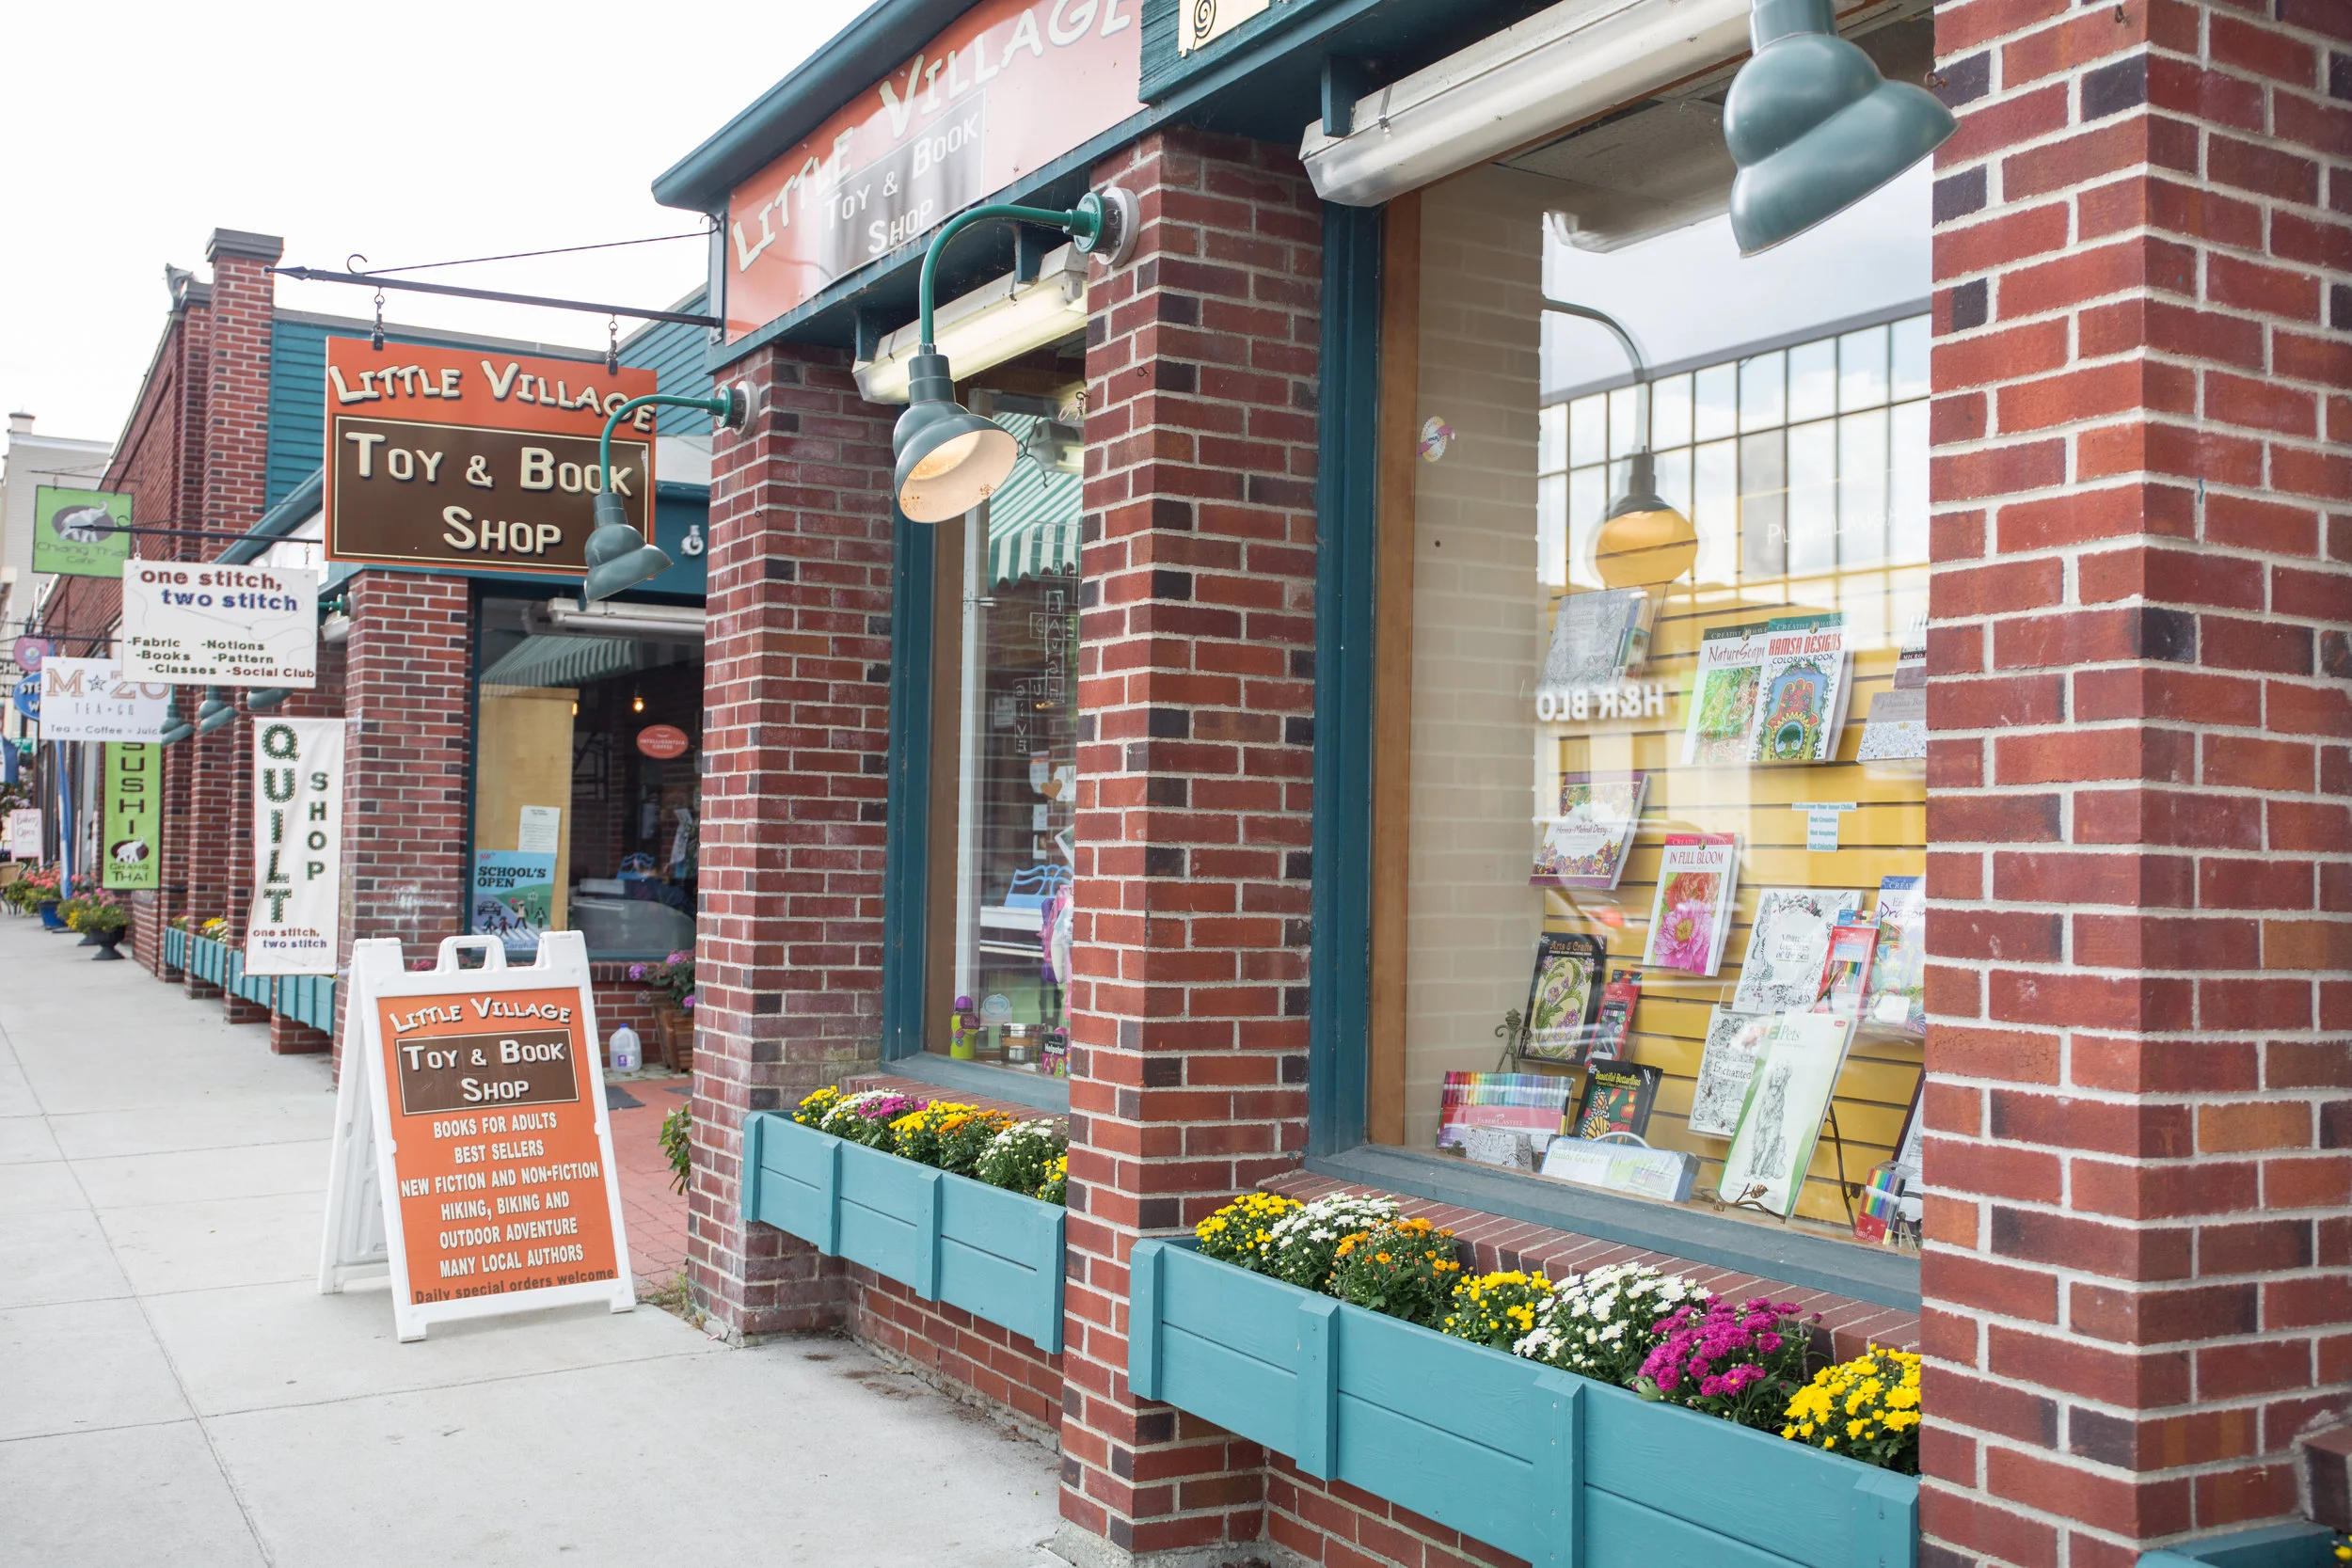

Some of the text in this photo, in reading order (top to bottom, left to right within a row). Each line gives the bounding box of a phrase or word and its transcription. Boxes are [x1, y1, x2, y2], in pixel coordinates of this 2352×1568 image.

[733, 0, 1131, 272] LITTLE VILLAGE
[824, 112, 979, 230] TOY & BOOK
[867, 198, 933, 254] SHOP
[328, 358, 657, 433] LITTLE VILLAGE
[345, 431, 633, 498] TOY & BOOK
[442, 504, 563, 555] SHOP
[140, 570, 282, 592] one stitch,
[162, 589, 298, 611] two stitch
[1776, 622, 1810, 631] CREATIVE
[1769, 633, 1842, 656] HAMSA DESIGNS
[1772, 653, 1835, 665] COLORING BOOK
[283, 668, 314, 678] Club
[50, 724, 162, 736] Tea Coffee Juic
[262, 723, 301, 923] QUILT
[307, 771, 329, 880] SHOP
[1669, 850, 1724, 864] IN FULL BLOOM
[112, 871, 148, 881] THAI
[477, 877, 515, 888] OPEN
[478, 866, 546, 878] SCHOOL'S
[263, 939, 326, 948] two stitch
[389, 996, 572, 1033] LITTLE VILLAGE
[1780, 1024, 1801, 1040] Pets
[402, 1039, 565, 1070] TOY & BOOK
[1712, 1061, 1752, 1079] Enchanted
[460, 1077, 530, 1102] SHOP
[433, 1112, 558, 1139] BOOKS FOR ADULTS
[453, 1139, 545, 1164] BEST SELLERS
[401, 1161, 599, 1197] NEW FICTION AND NON-FICTION
[440, 1191, 570, 1222] HIKING, BIKING AND
[439, 1216, 578, 1250] OUTDOOR ADVENTURE
[439, 1243, 584, 1278] MANY LOCAL AUTHORS
[415, 1268, 614, 1305] Daily special orders welcome
